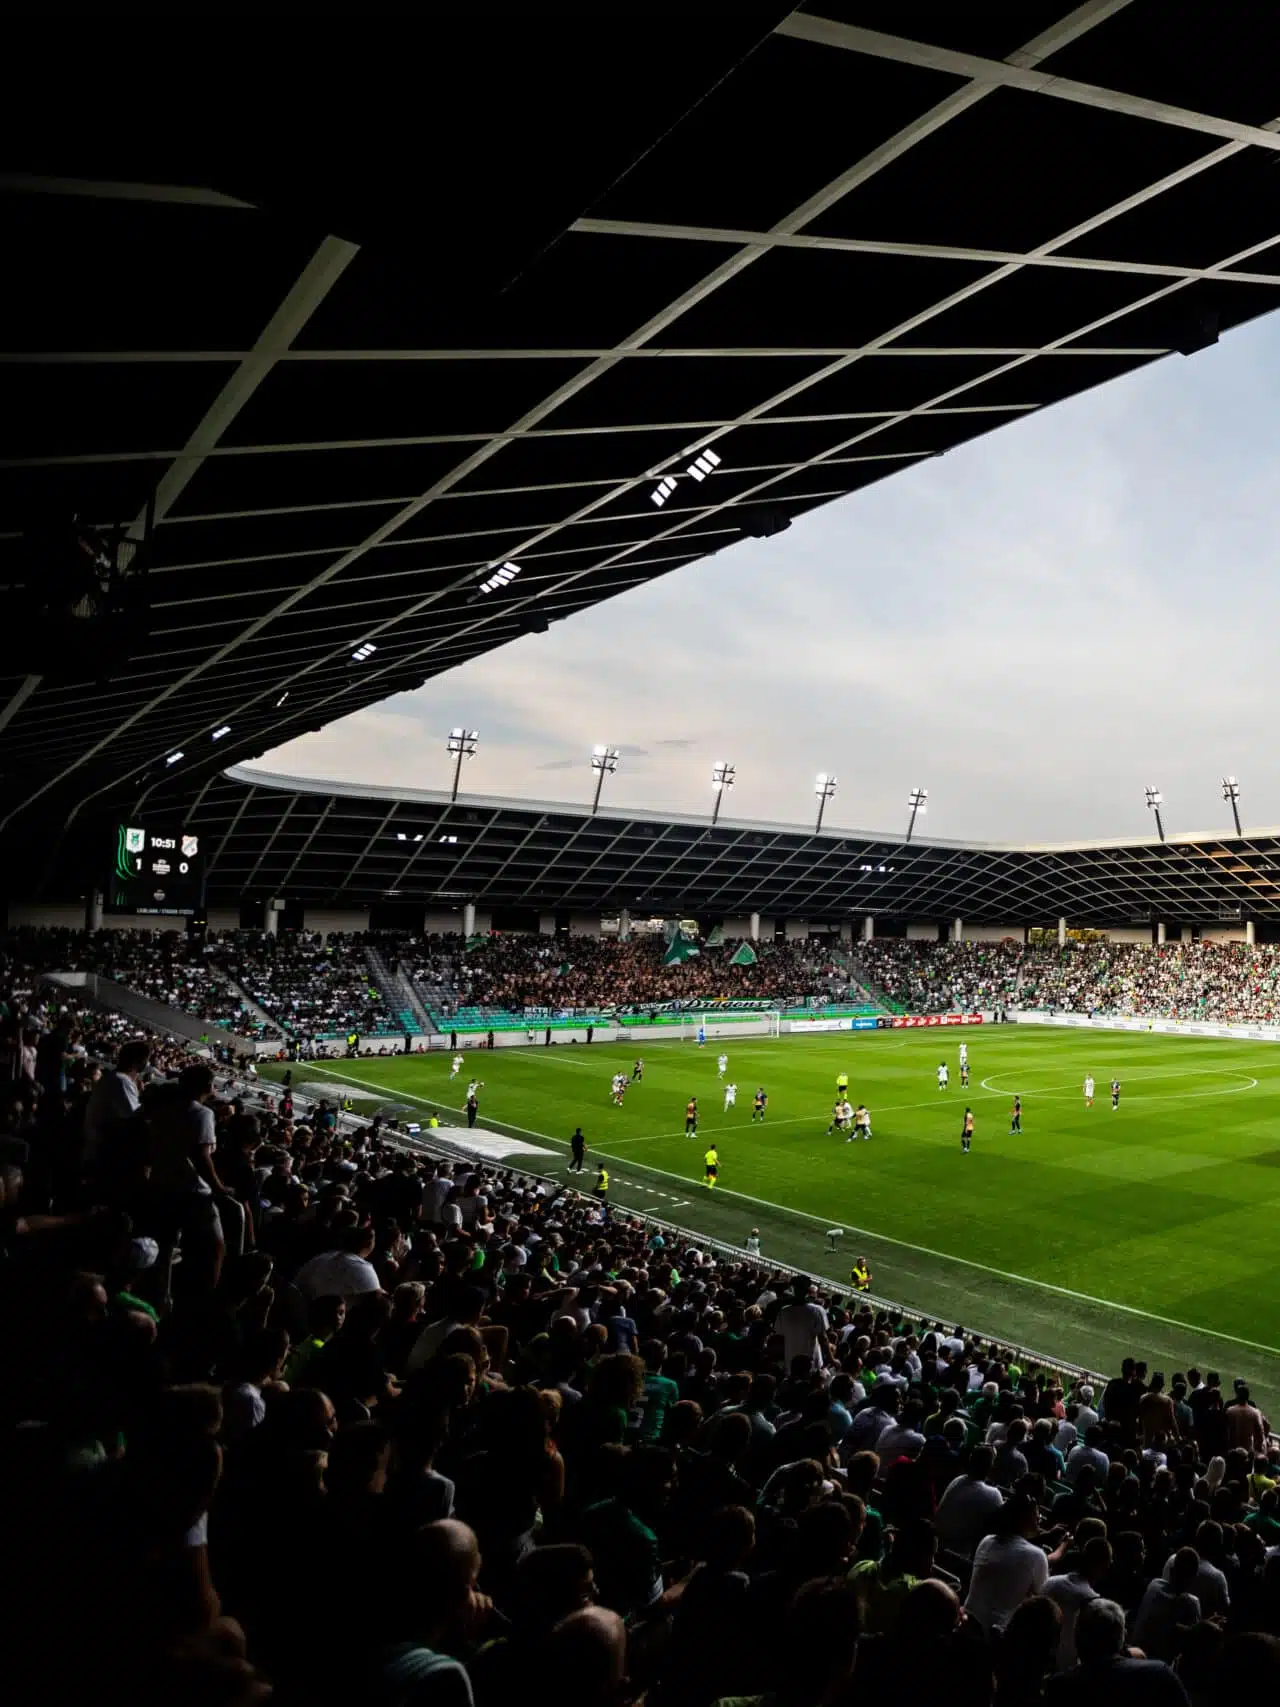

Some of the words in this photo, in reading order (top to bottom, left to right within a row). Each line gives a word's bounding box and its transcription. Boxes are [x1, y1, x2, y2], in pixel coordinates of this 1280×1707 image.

[151, 837, 176, 849] 10:51
[136, 858, 142, 871] 1
[179, 862, 188, 874] 0
